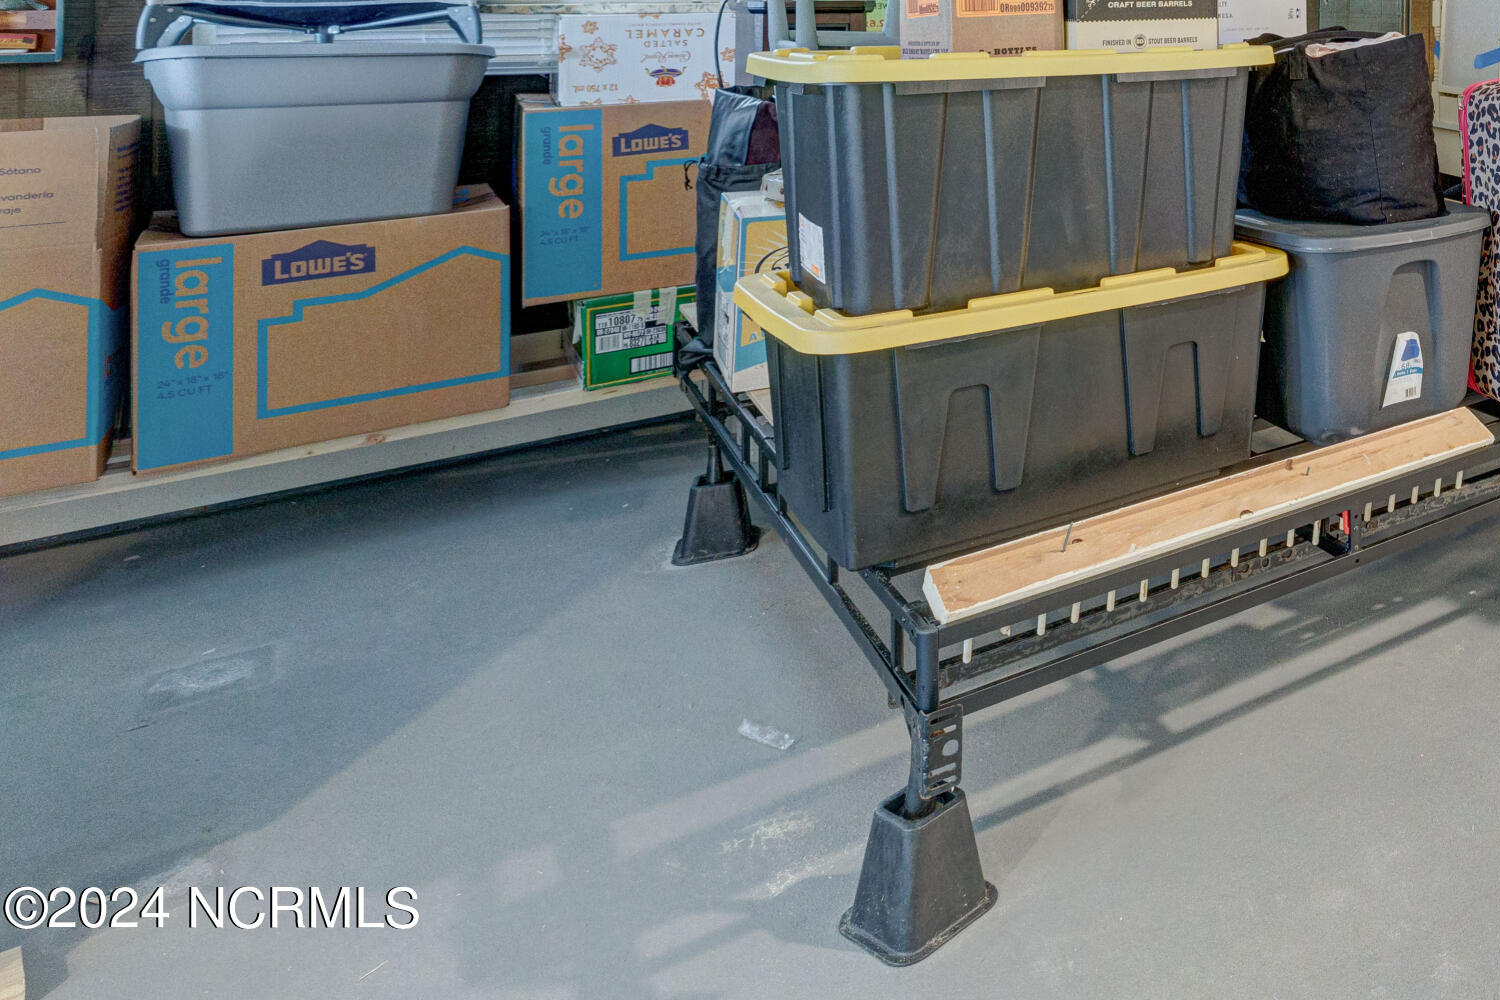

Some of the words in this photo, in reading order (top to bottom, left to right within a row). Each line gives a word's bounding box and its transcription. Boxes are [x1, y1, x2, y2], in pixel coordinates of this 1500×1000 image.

[1158, 0, 1193, 8] BARRELS
[625, 28, 704, 39] CARAMEL
[644, 39, 688, 47] SALTED
[1102, 38, 1125, 46] FINISHED
[540, 126, 553, 165] grande
[620, 134, 683, 153] LOWE'S
[548, 124, 594, 219] large
[0, 191, 54, 201] vandería
[0, 207, 21, 215] raje
[274, 252, 368, 280] LOWE'S
[156, 259, 173, 304] grande
[161, 256, 223, 370] large
[177, 387, 195, 397] CU
[199, 385, 212, 394] FT
